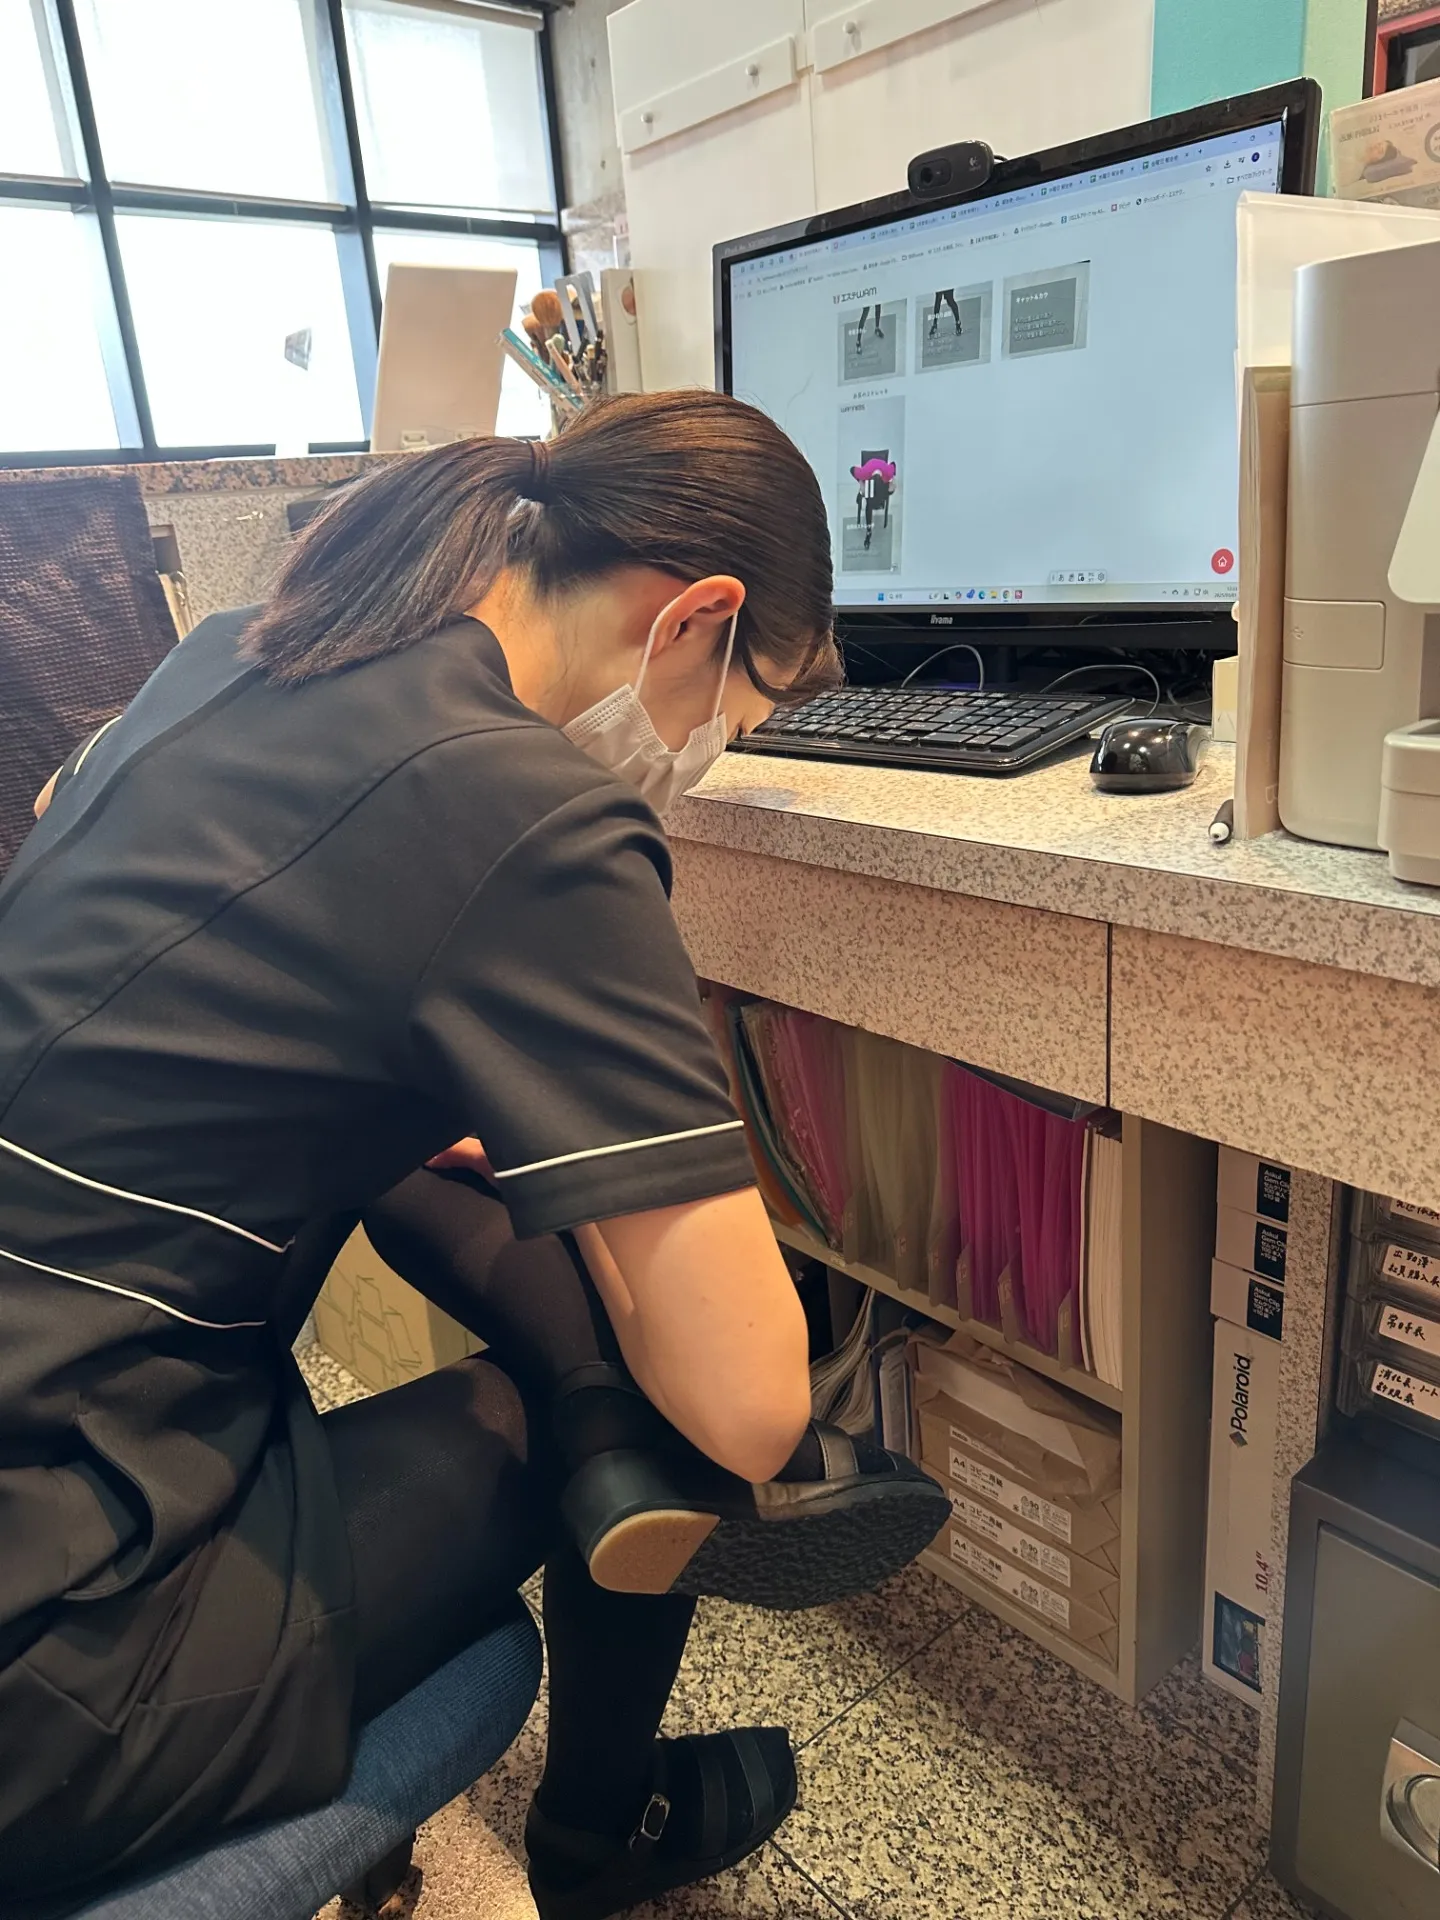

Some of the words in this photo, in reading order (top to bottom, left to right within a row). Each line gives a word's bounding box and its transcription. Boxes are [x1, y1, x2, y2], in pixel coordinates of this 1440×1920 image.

[1230, 1353, 1251, 1433] Polaroid
[953, 1457, 966, 1468] A4
[970, 1464, 1003, 1488] コピー用紙
[953, 1498, 965, 1509] A4
[969, 1505, 1003, 1530] コピー用紙
[954, 1538, 966, 1551] A4
[971, 1547, 1003, 1573] コピー用紙
